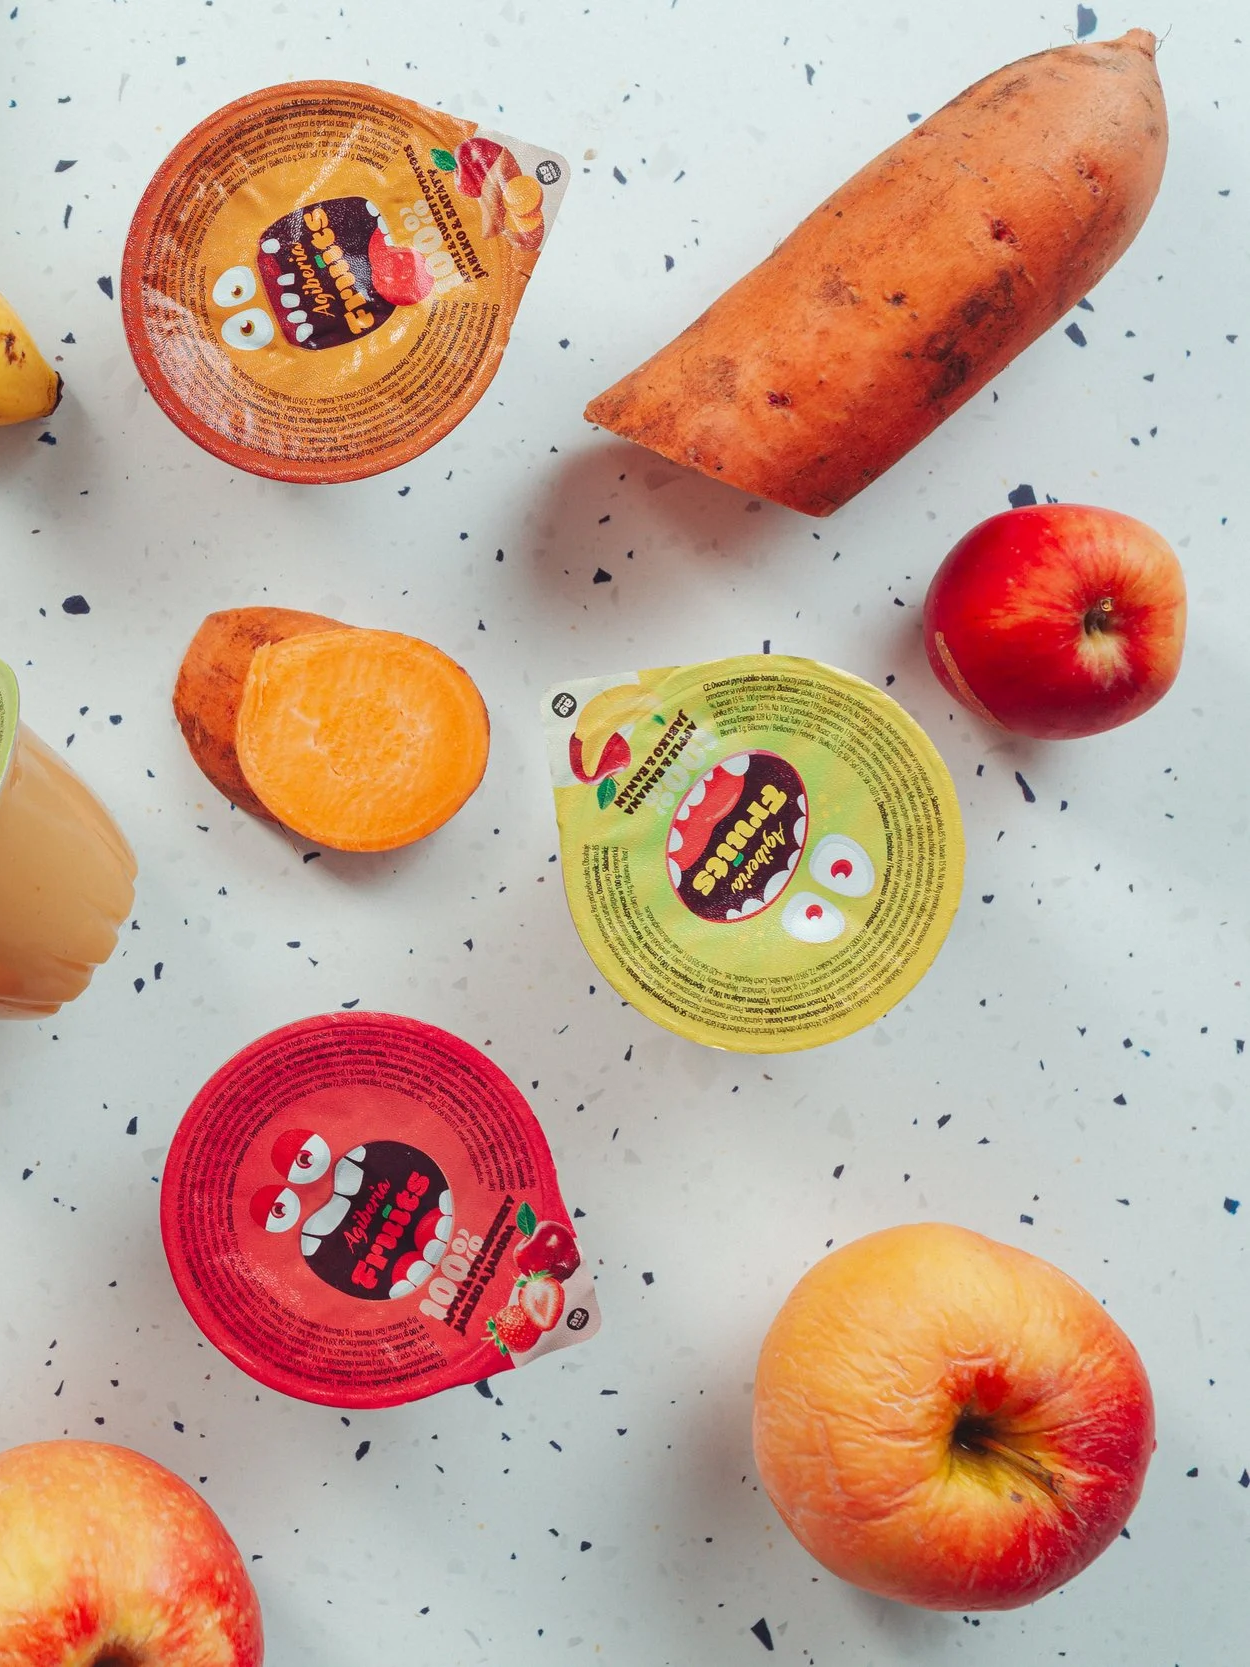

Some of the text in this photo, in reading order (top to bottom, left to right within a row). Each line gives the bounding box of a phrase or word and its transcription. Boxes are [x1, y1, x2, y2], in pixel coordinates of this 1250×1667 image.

[428, 199, 452, 242] SWEET
[451, 217, 463, 230] &
[456, 230, 489, 282] JABLKO
[291, 242, 336, 318] Agiberia
[303, 208, 374, 333] Fruits
[450, 248, 473, 283] APPLE
[561, 698, 574, 715] ag
[614, 709, 689, 808] JABLKO & BANÁN
[624, 720, 697, 815] APPLE & BANANA
[693, 785, 786, 895] Fruits
[731, 823, 785, 893] Agiberia
[344, 1180, 391, 1250] Agiberia
[352, 1172, 429, 1289] Fruits
[420, 1229, 483, 1320] 100%
